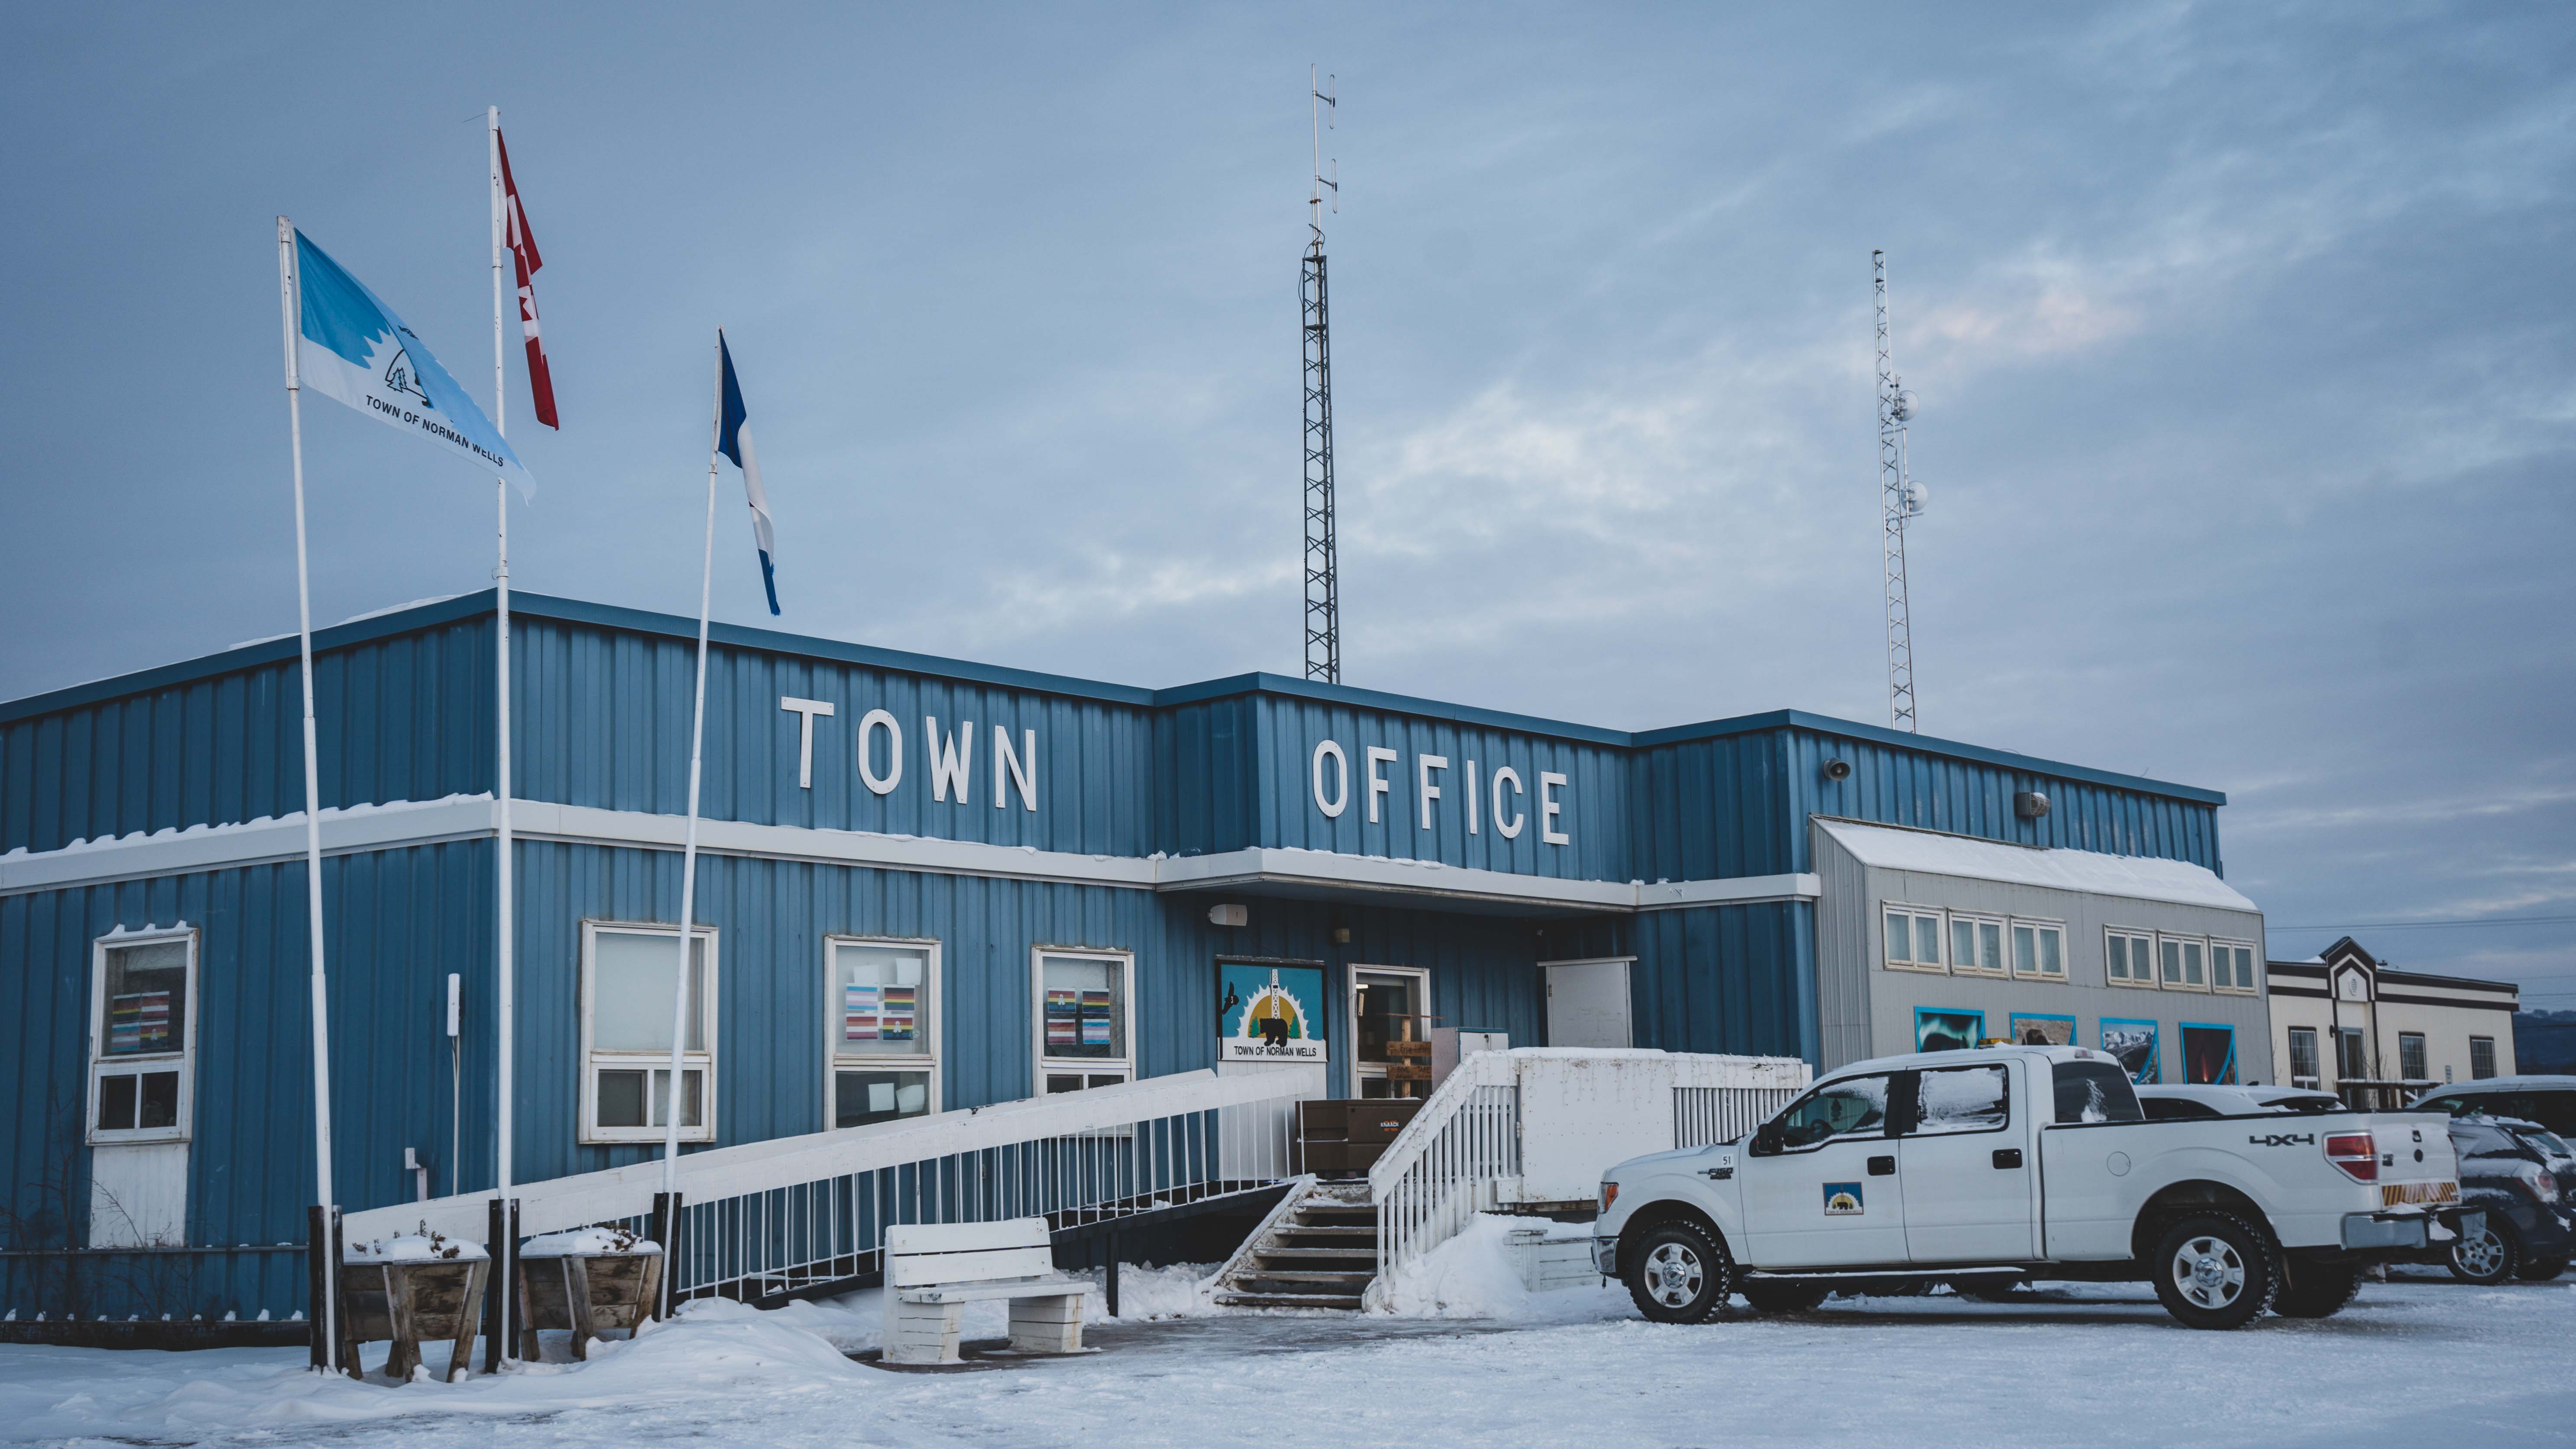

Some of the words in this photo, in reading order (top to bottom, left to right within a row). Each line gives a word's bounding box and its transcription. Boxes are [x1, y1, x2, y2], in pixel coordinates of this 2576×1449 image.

[366, 395, 400, 418] TOWN
[403, 411, 420, 425] OF
[422, 419, 469, 448] NORMAN
[472, 443, 504, 467] WELLS
[781, 696, 1037, 812] TOWN
[1312, 739, 1569, 845] OFFICE
[1234, 1046, 1254, 1055] TOWN
[1255, 1046, 1264, 1056] OF
[1266, 1046, 1294, 1056] NORMAN
[1295, 1047, 1317, 1056] WELLS
[1723, 1156, 1730, 1165] 51
